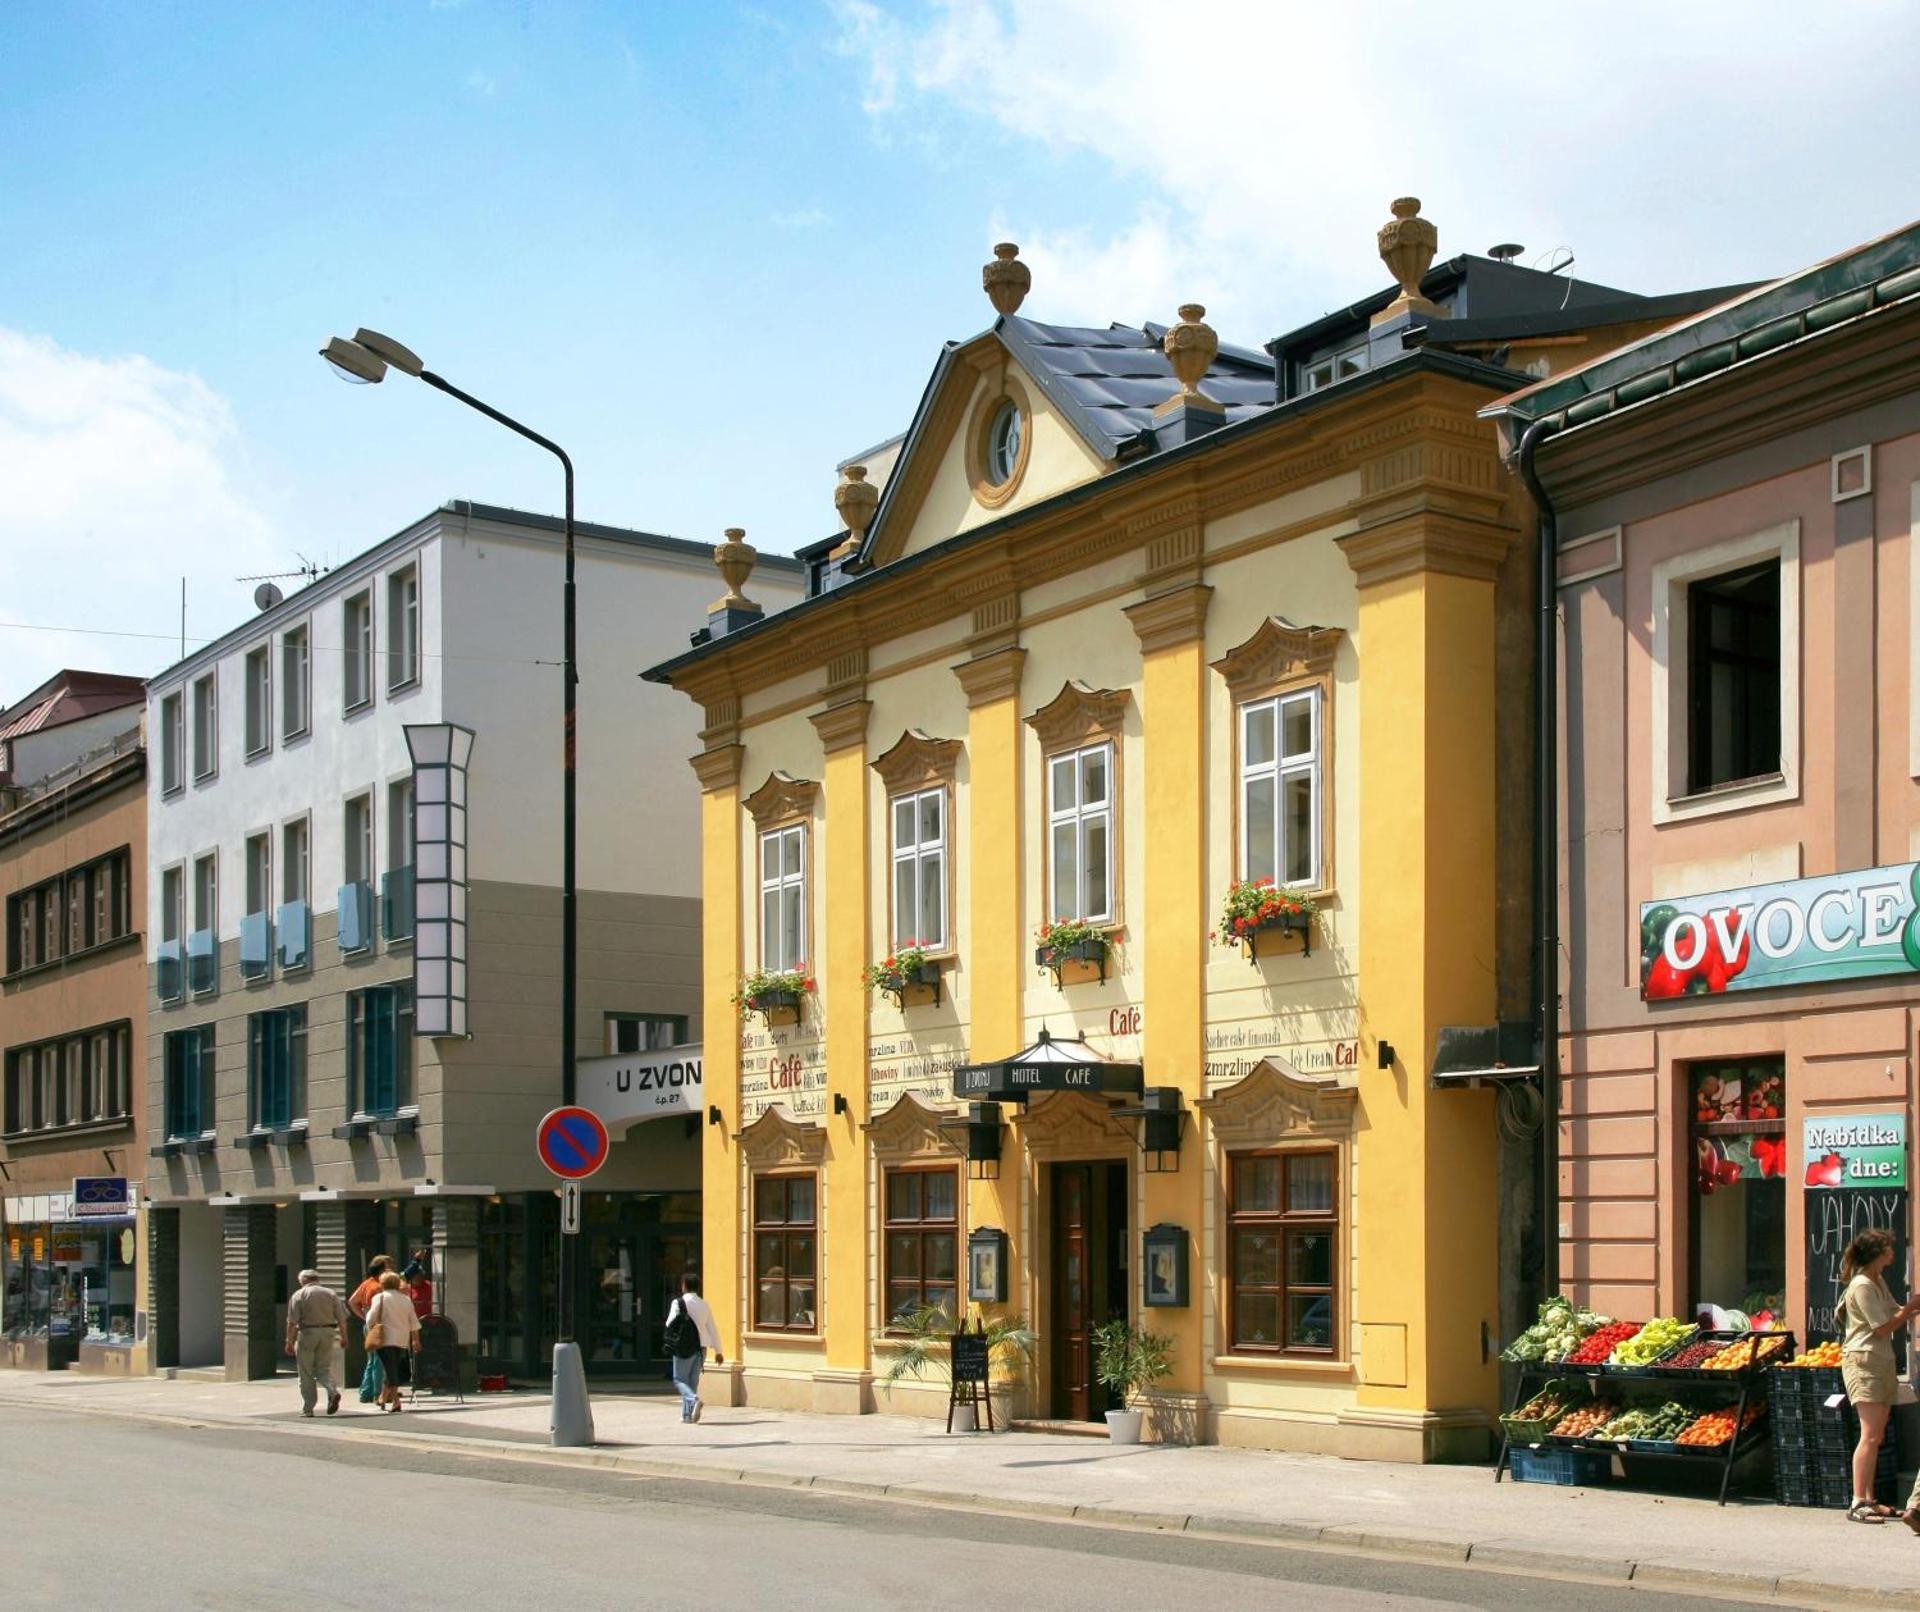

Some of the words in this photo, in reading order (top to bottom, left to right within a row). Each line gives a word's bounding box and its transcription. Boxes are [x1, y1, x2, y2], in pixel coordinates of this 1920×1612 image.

[1664, 882, 1906, 970] OVOCE
[1109, 1006, 1141, 1036] Café
[616, 1069, 630, 1092] U
[639, 1060, 702, 1091] ZVON
[769, 1053, 802, 1090] Café
[1011, 1068, 1040, 1084] HOTEL
[1808, 1124, 1900, 1149] Nabídka
[1849, 1157, 1899, 1179] dne:
